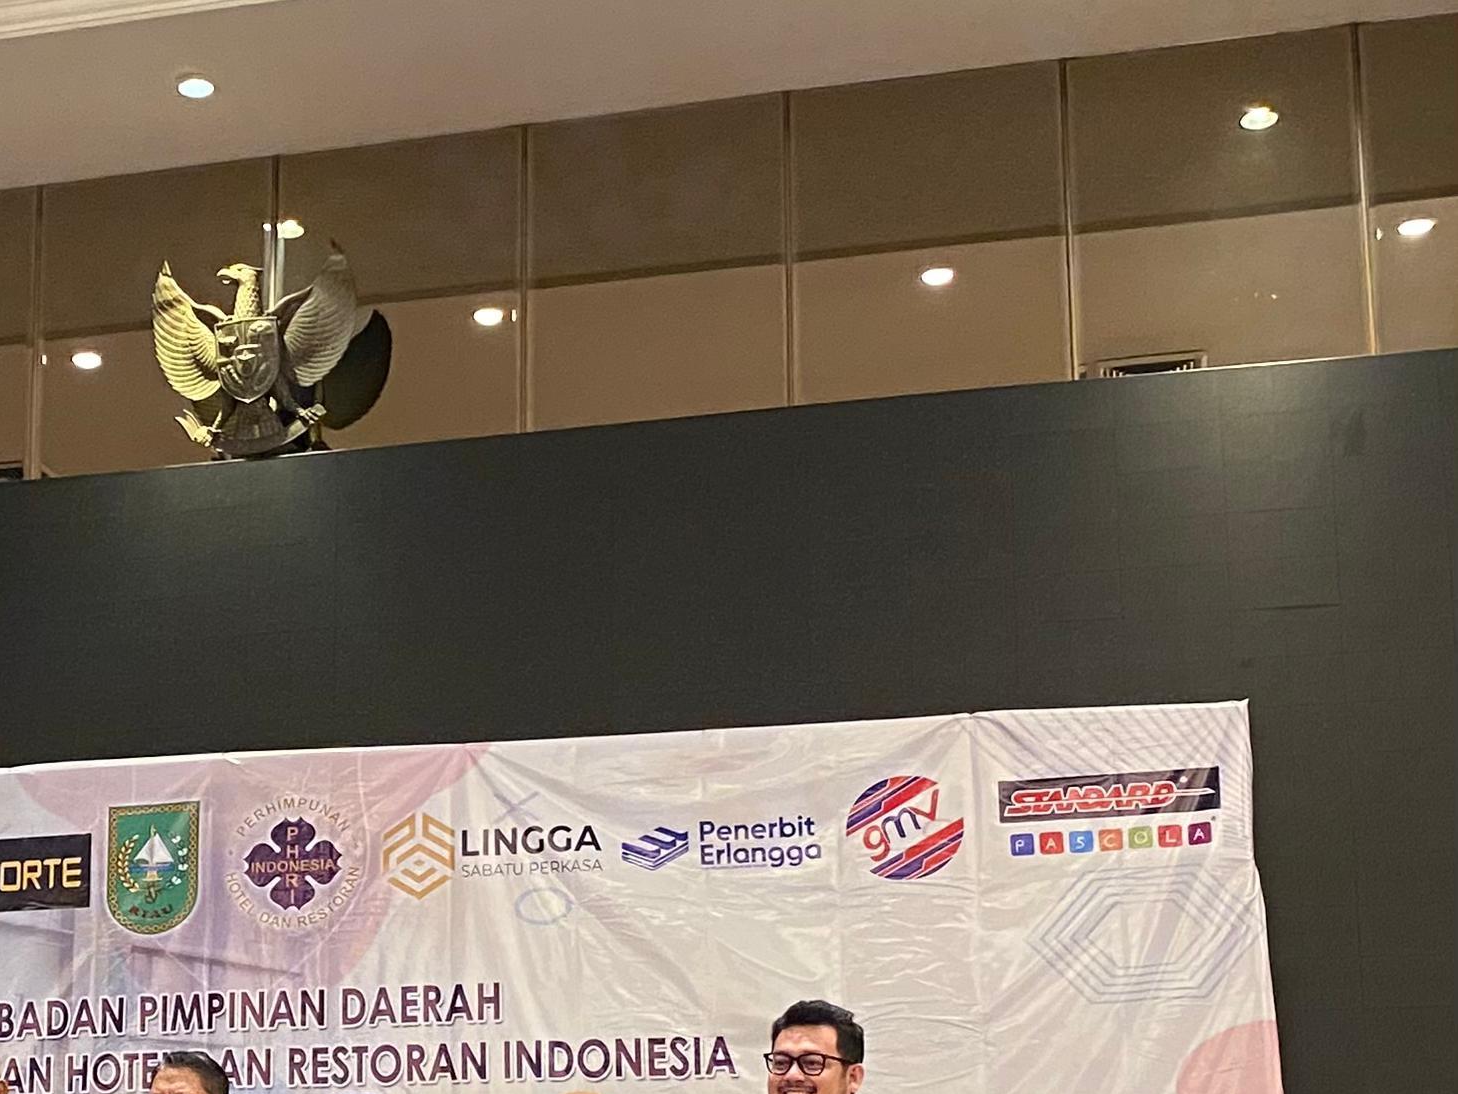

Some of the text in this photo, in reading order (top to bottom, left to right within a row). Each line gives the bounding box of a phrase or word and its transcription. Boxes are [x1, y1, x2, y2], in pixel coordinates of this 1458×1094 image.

[237, 797, 351, 838] PERHIMPUNAN
[698, 816, 816, 842] Penerbit
[460, 824, 603, 857] LINGGA
[699, 839, 822, 868] Erlangga
[1012, 825, 1210, 855] PASCOLA
[250, 857, 336, 873] INDONESIA
[461, 858, 604, 877] SABATU PERKASA
[226, 866, 360, 928] HOTEL DAN RESTORAN
[142, 988, 325, 1034] PIMPINAN
[341, 983, 501, 1025] DAERAH
[67, 1052, 160, 1092] HOTE
[288, 1041, 486, 1085] RESTORAN
[503, 1036, 737, 1081] INDONESIA
